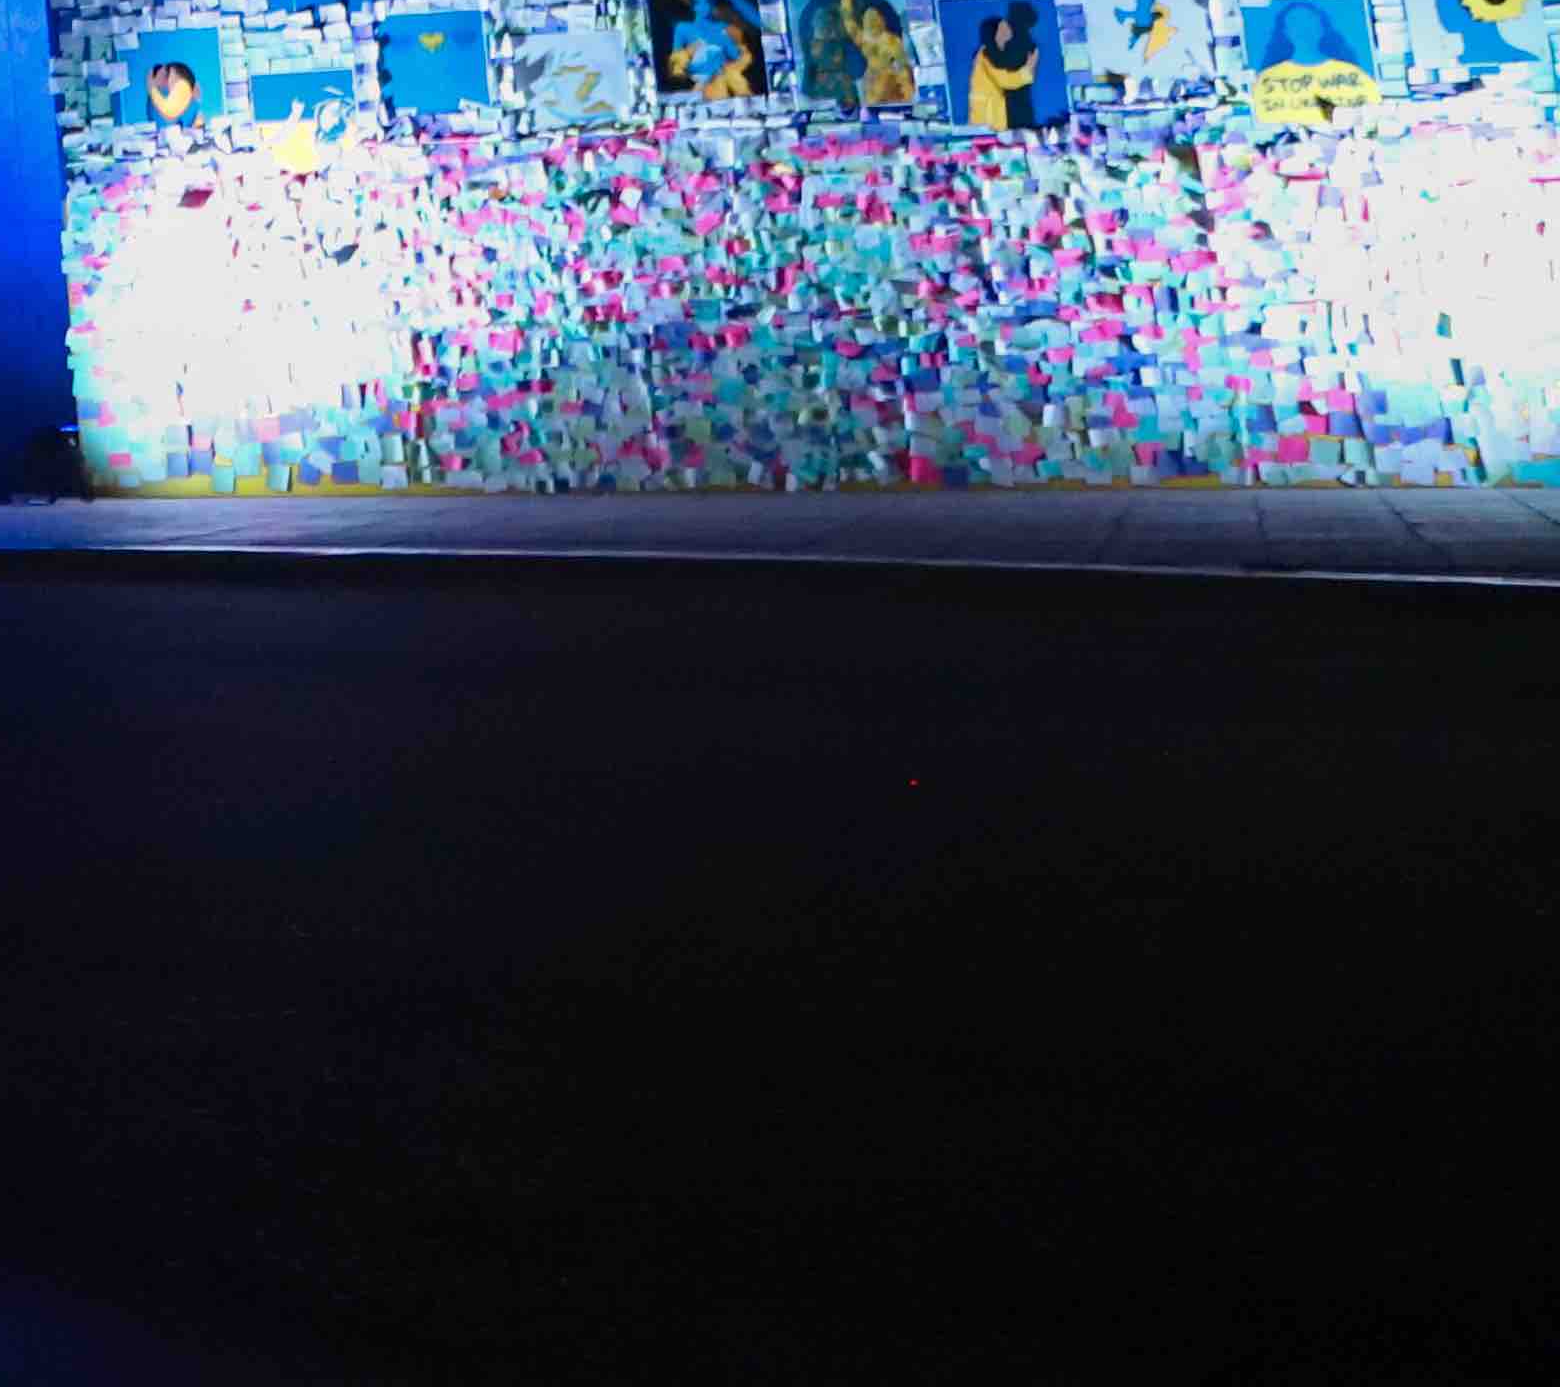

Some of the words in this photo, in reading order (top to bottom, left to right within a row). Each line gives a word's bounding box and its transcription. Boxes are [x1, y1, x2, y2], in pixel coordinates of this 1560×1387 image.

[1261, 74, 1313, 93] STOP
[1319, 71, 1360, 89] WAR
[1289, 94, 1367, 110] UKRINE
